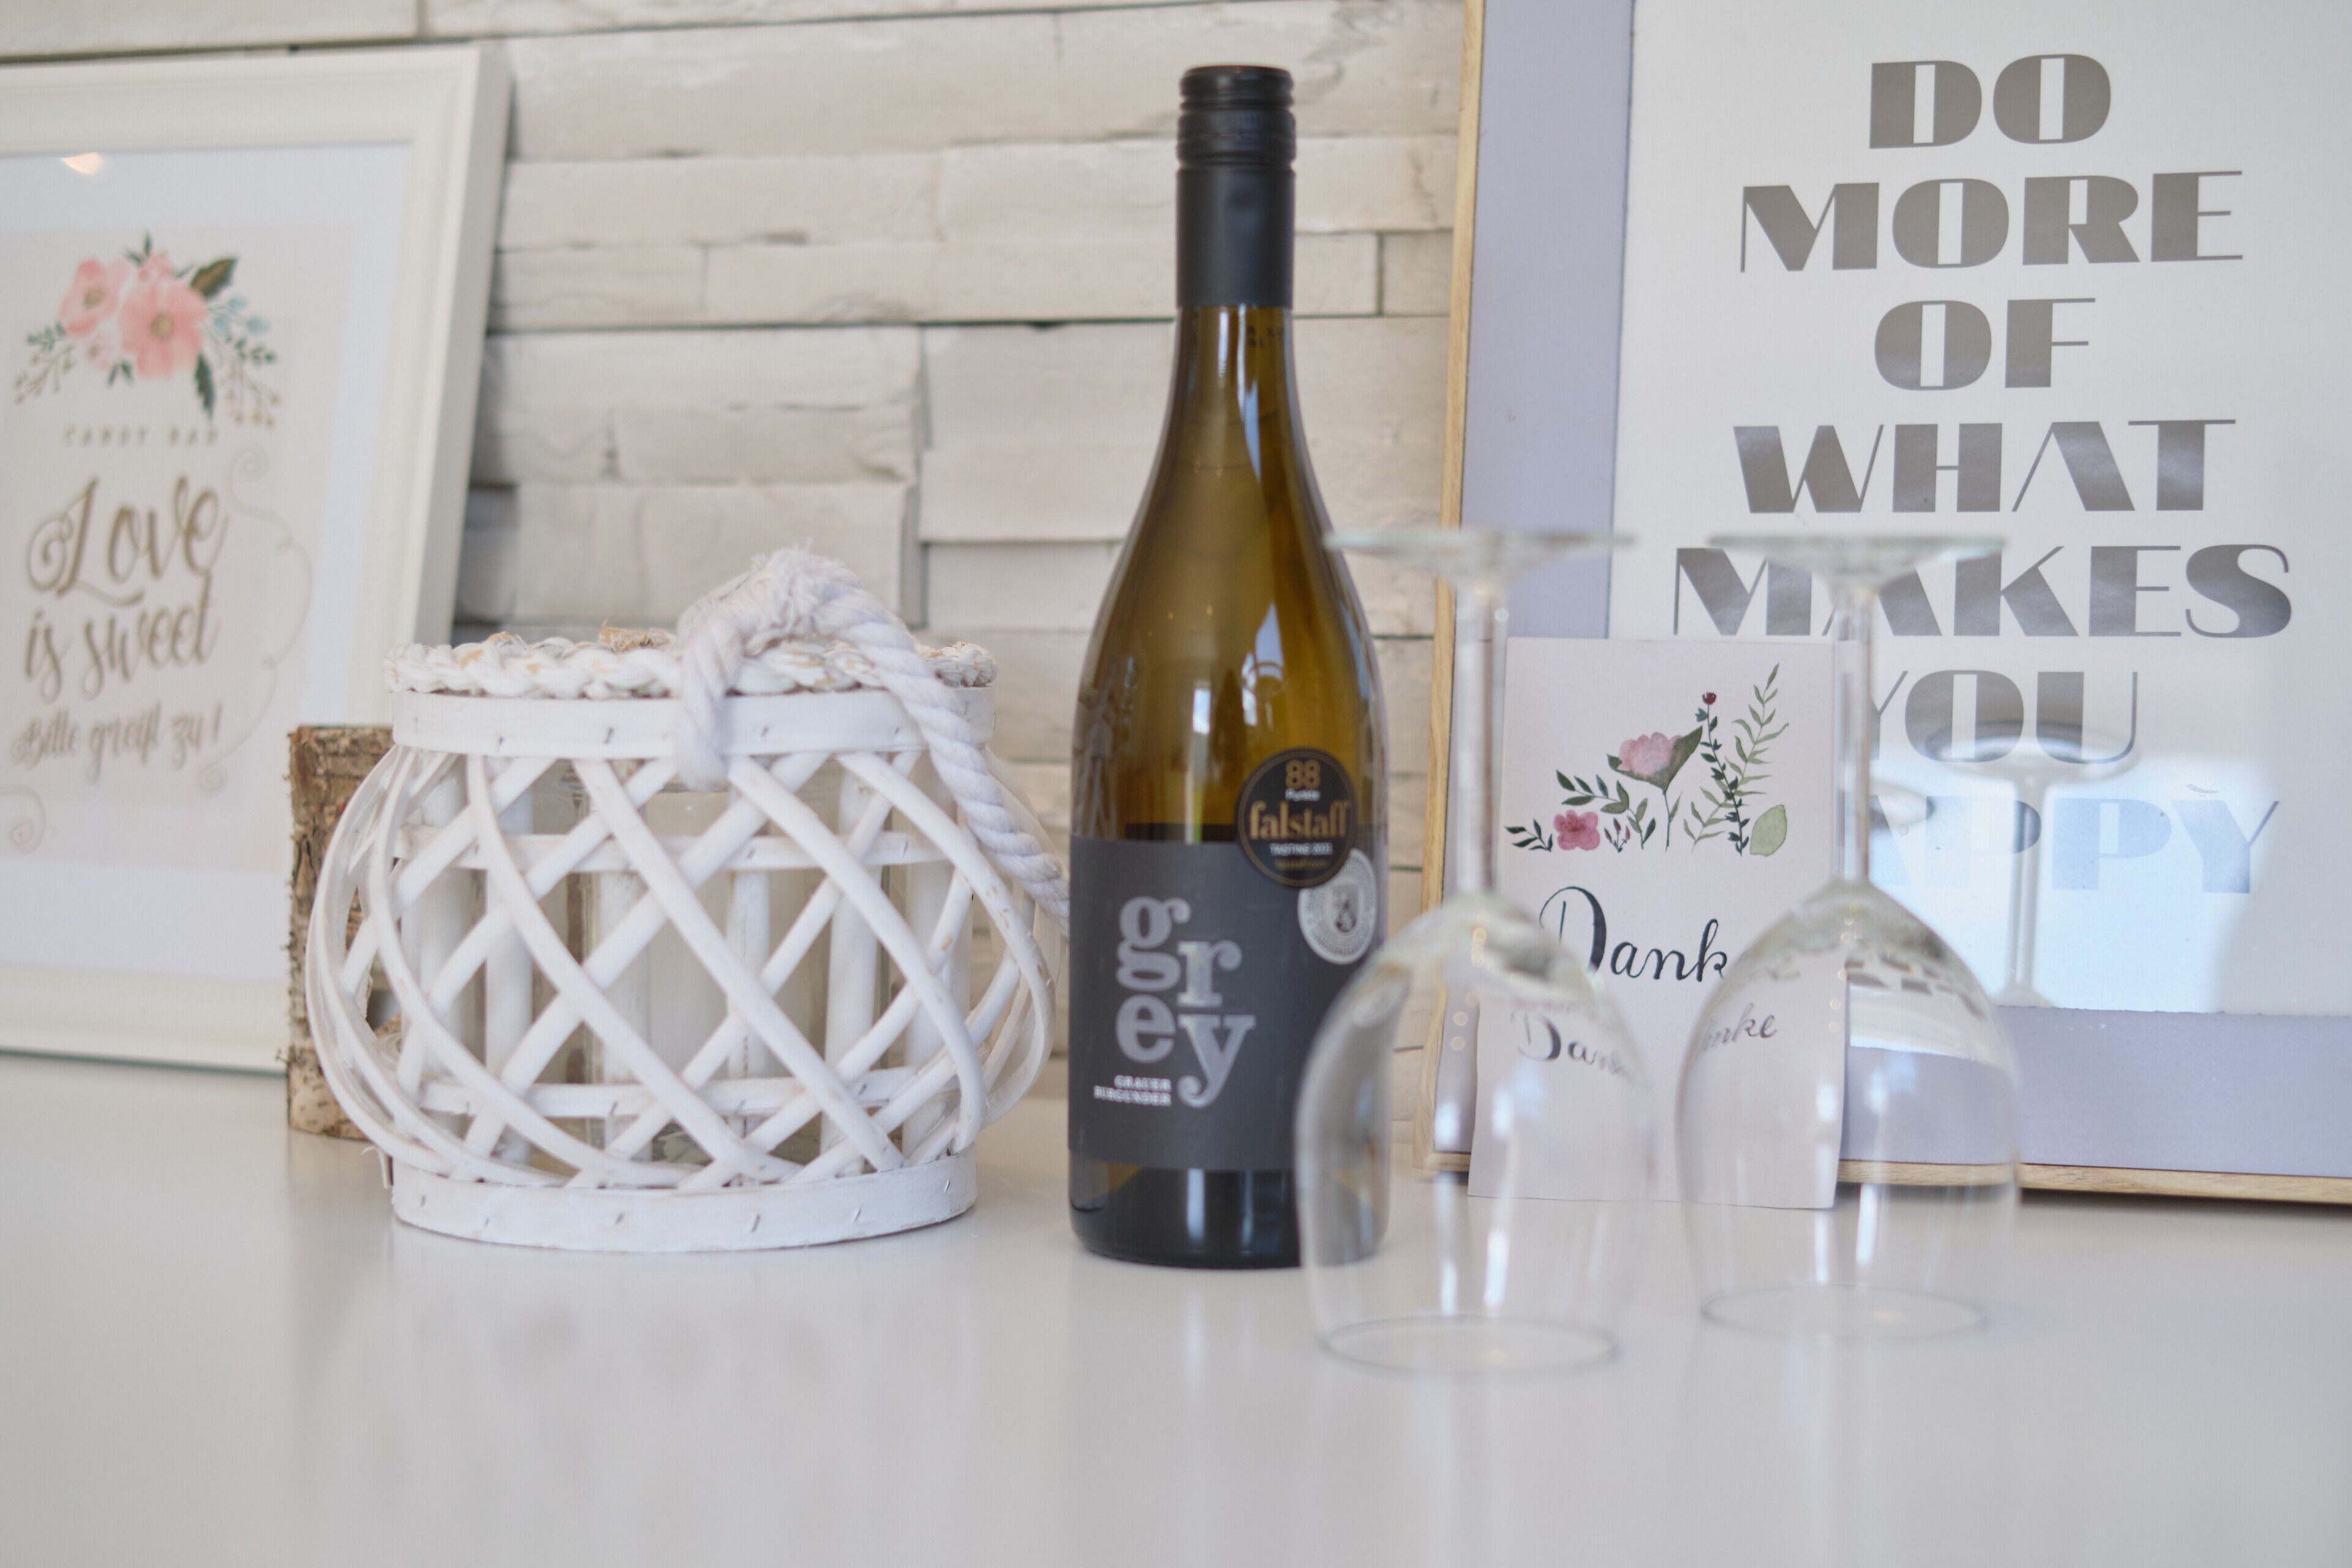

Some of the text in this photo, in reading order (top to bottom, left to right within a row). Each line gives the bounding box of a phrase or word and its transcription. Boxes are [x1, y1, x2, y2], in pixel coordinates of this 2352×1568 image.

[1869, 54, 2111, 149] DO
[1740, 170, 2243, 273] MORE
[1874, 298, 2095, 391] OF
[1733, 419, 2236, 513] WHAT
[26, 474, 230, 608] Love
[1673, 543, 2292, 638] MAKES
[24, 573, 222, 704] is sweet
[1250, 800, 1351, 840] falstaff
[1286, 760, 1321, 788] 88
[1539, 886, 1727, 982] Dank
